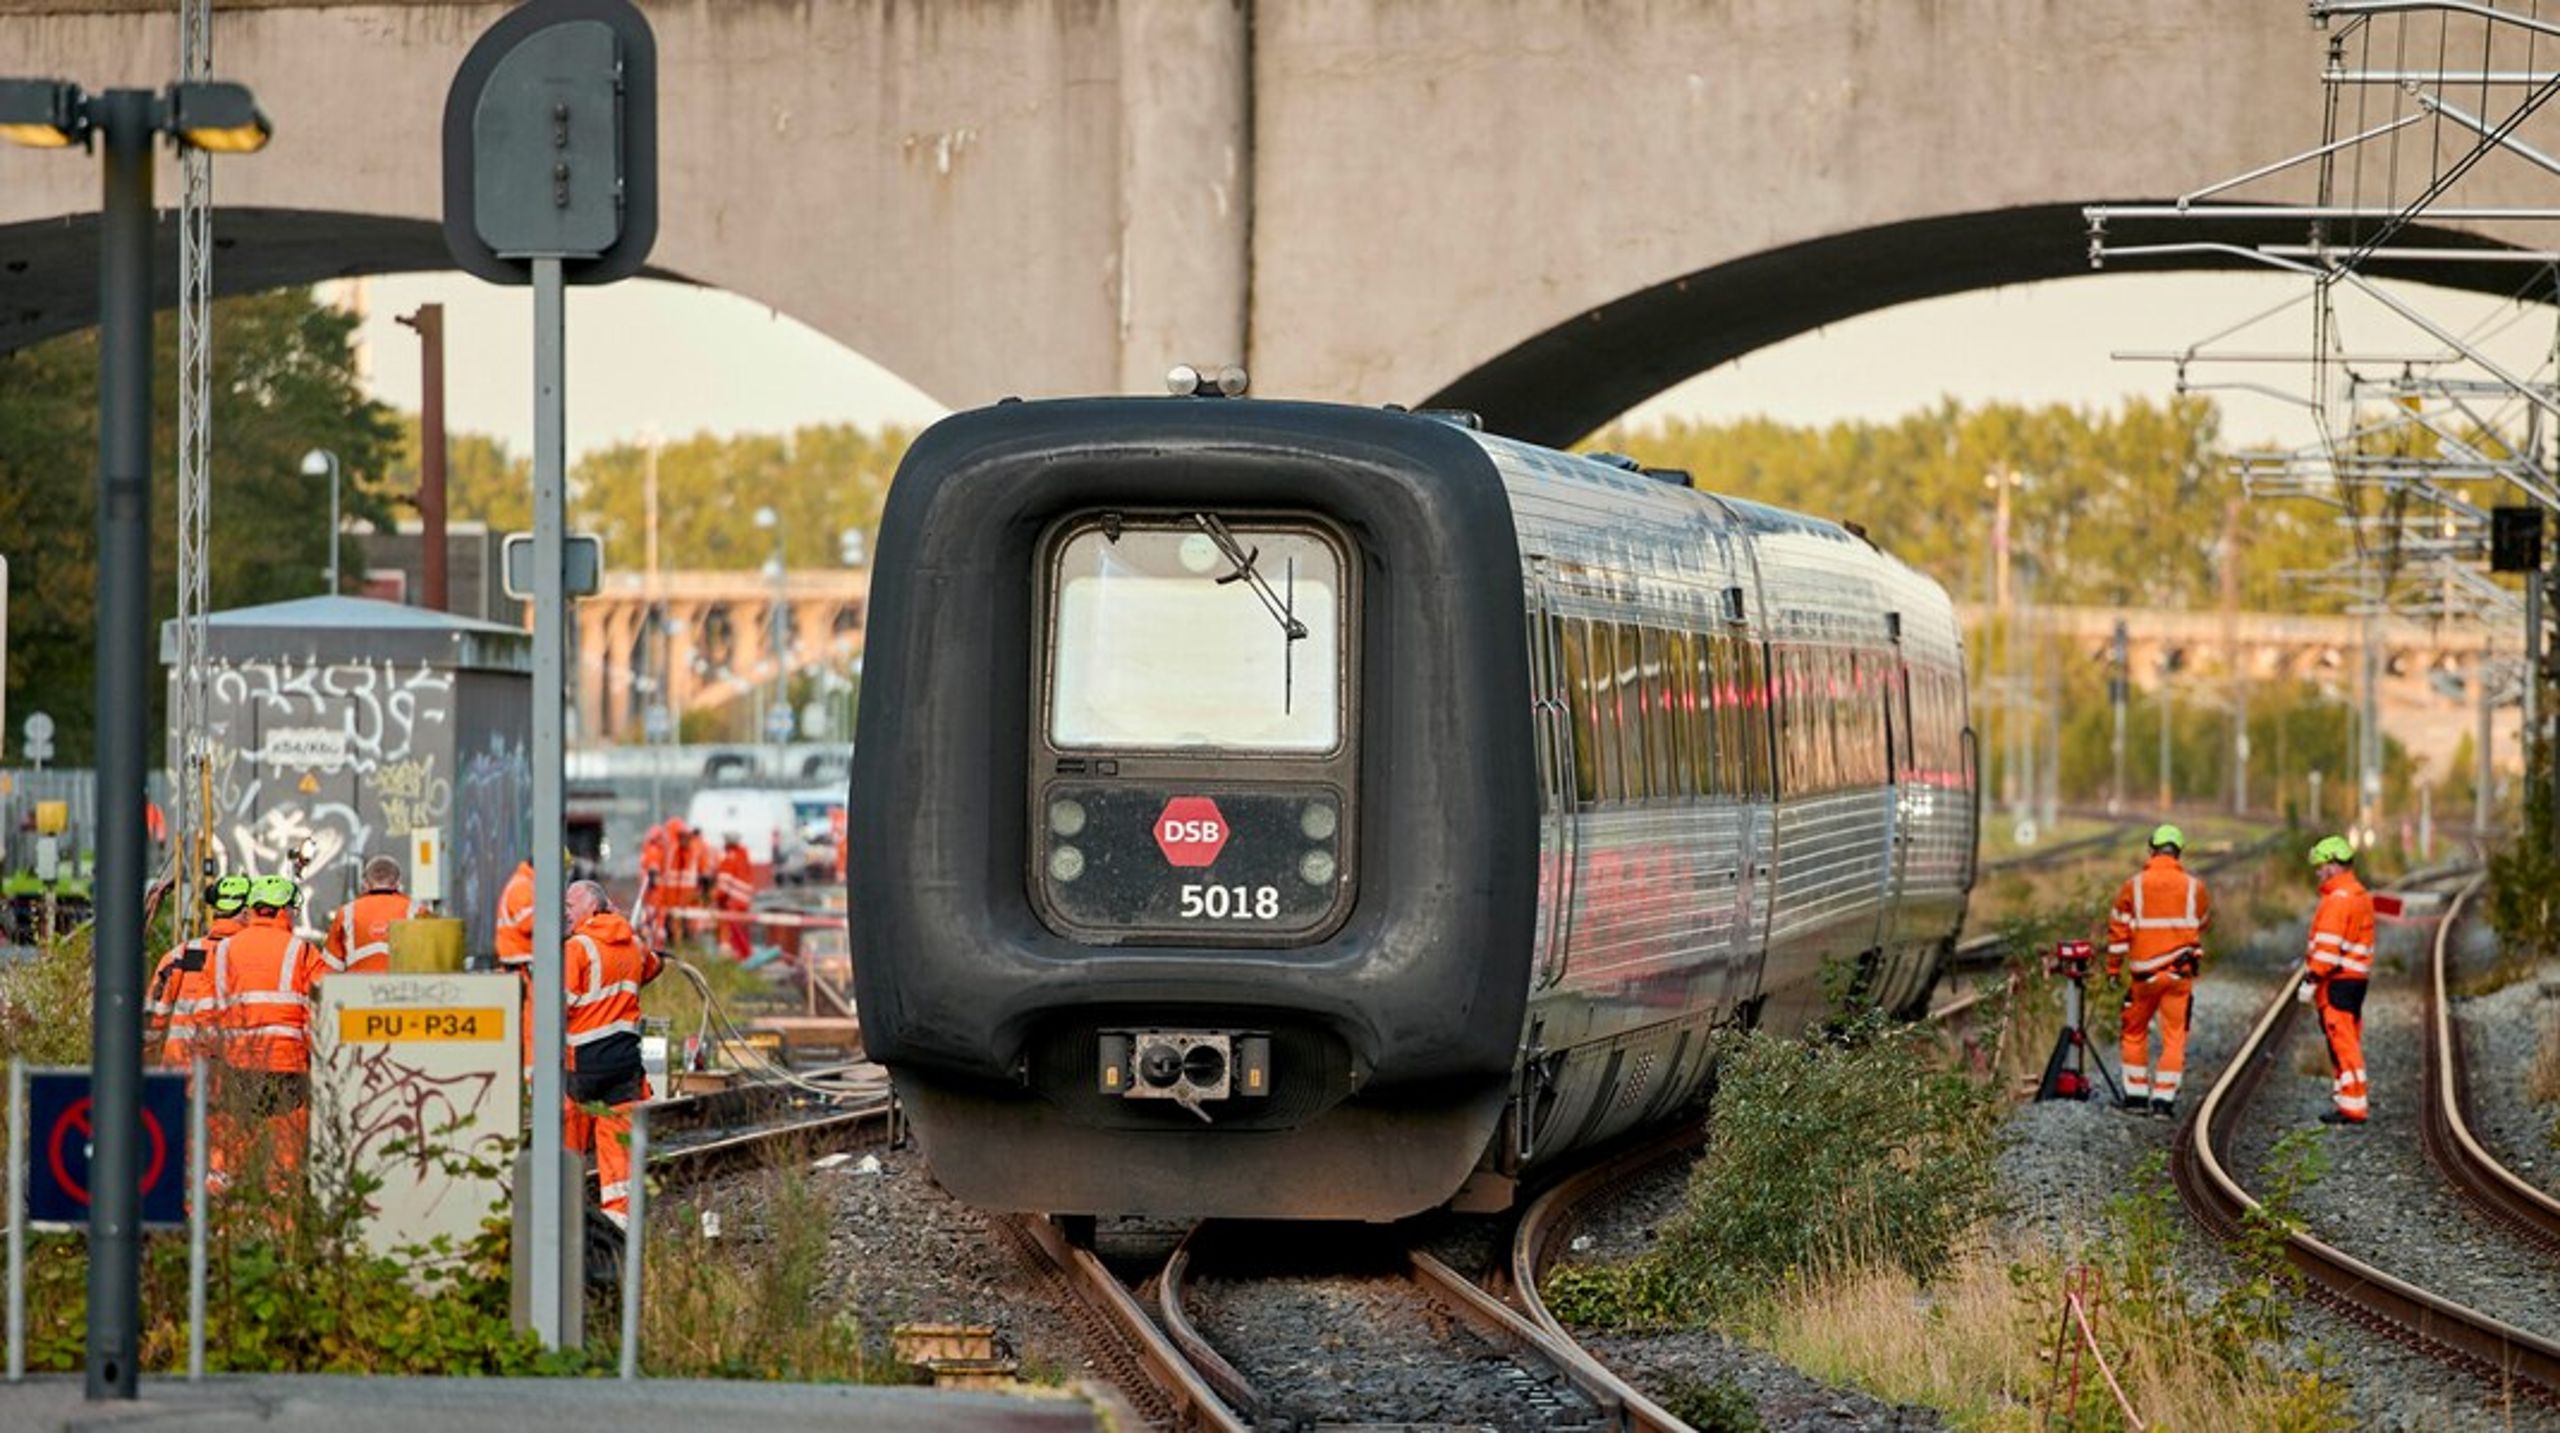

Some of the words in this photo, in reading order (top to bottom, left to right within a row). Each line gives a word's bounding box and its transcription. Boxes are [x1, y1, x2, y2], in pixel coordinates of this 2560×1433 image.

[1164, 820, 1219, 843] DSB
[1180, 884, 1279, 919] 5018
[367, 1015, 402, 1036] PU
[425, 1015, 477, 1036] P34
